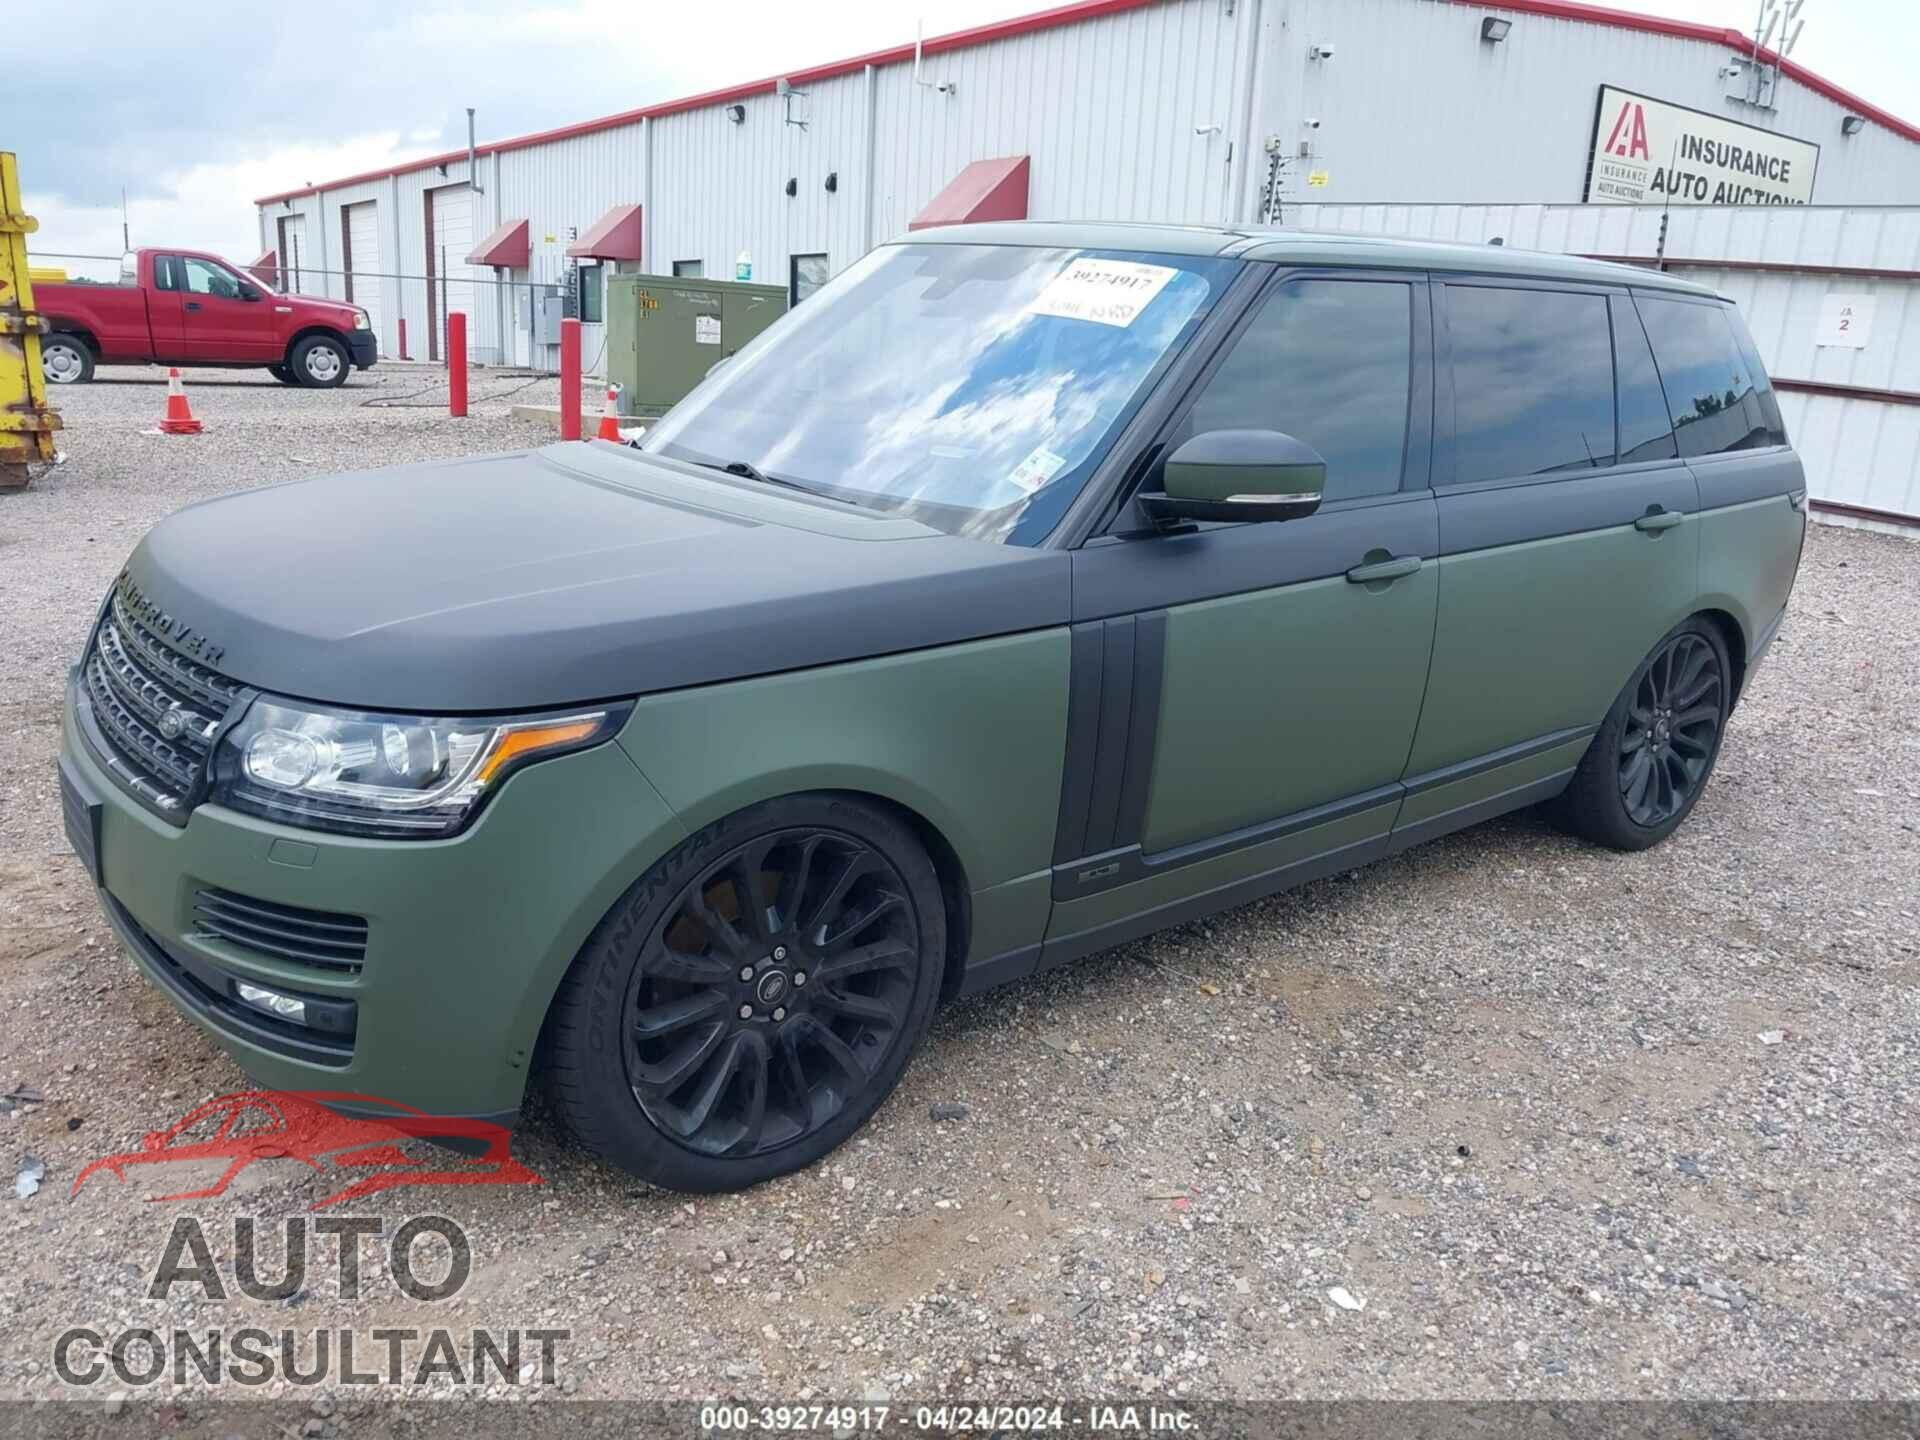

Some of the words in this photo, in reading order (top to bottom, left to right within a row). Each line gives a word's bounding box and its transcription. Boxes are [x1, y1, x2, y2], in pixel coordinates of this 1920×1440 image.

[1600, 164, 1648, 184] INSURANCE
[1681, 133, 1791, 184] INSURANCE
[1650, 167, 1708, 201] AUTO
[1712, 181, 1805, 205] AUCTI
[1838, 319, 1849, 331] 2
[588, 815, 732, 1053] ONTINENTAL
